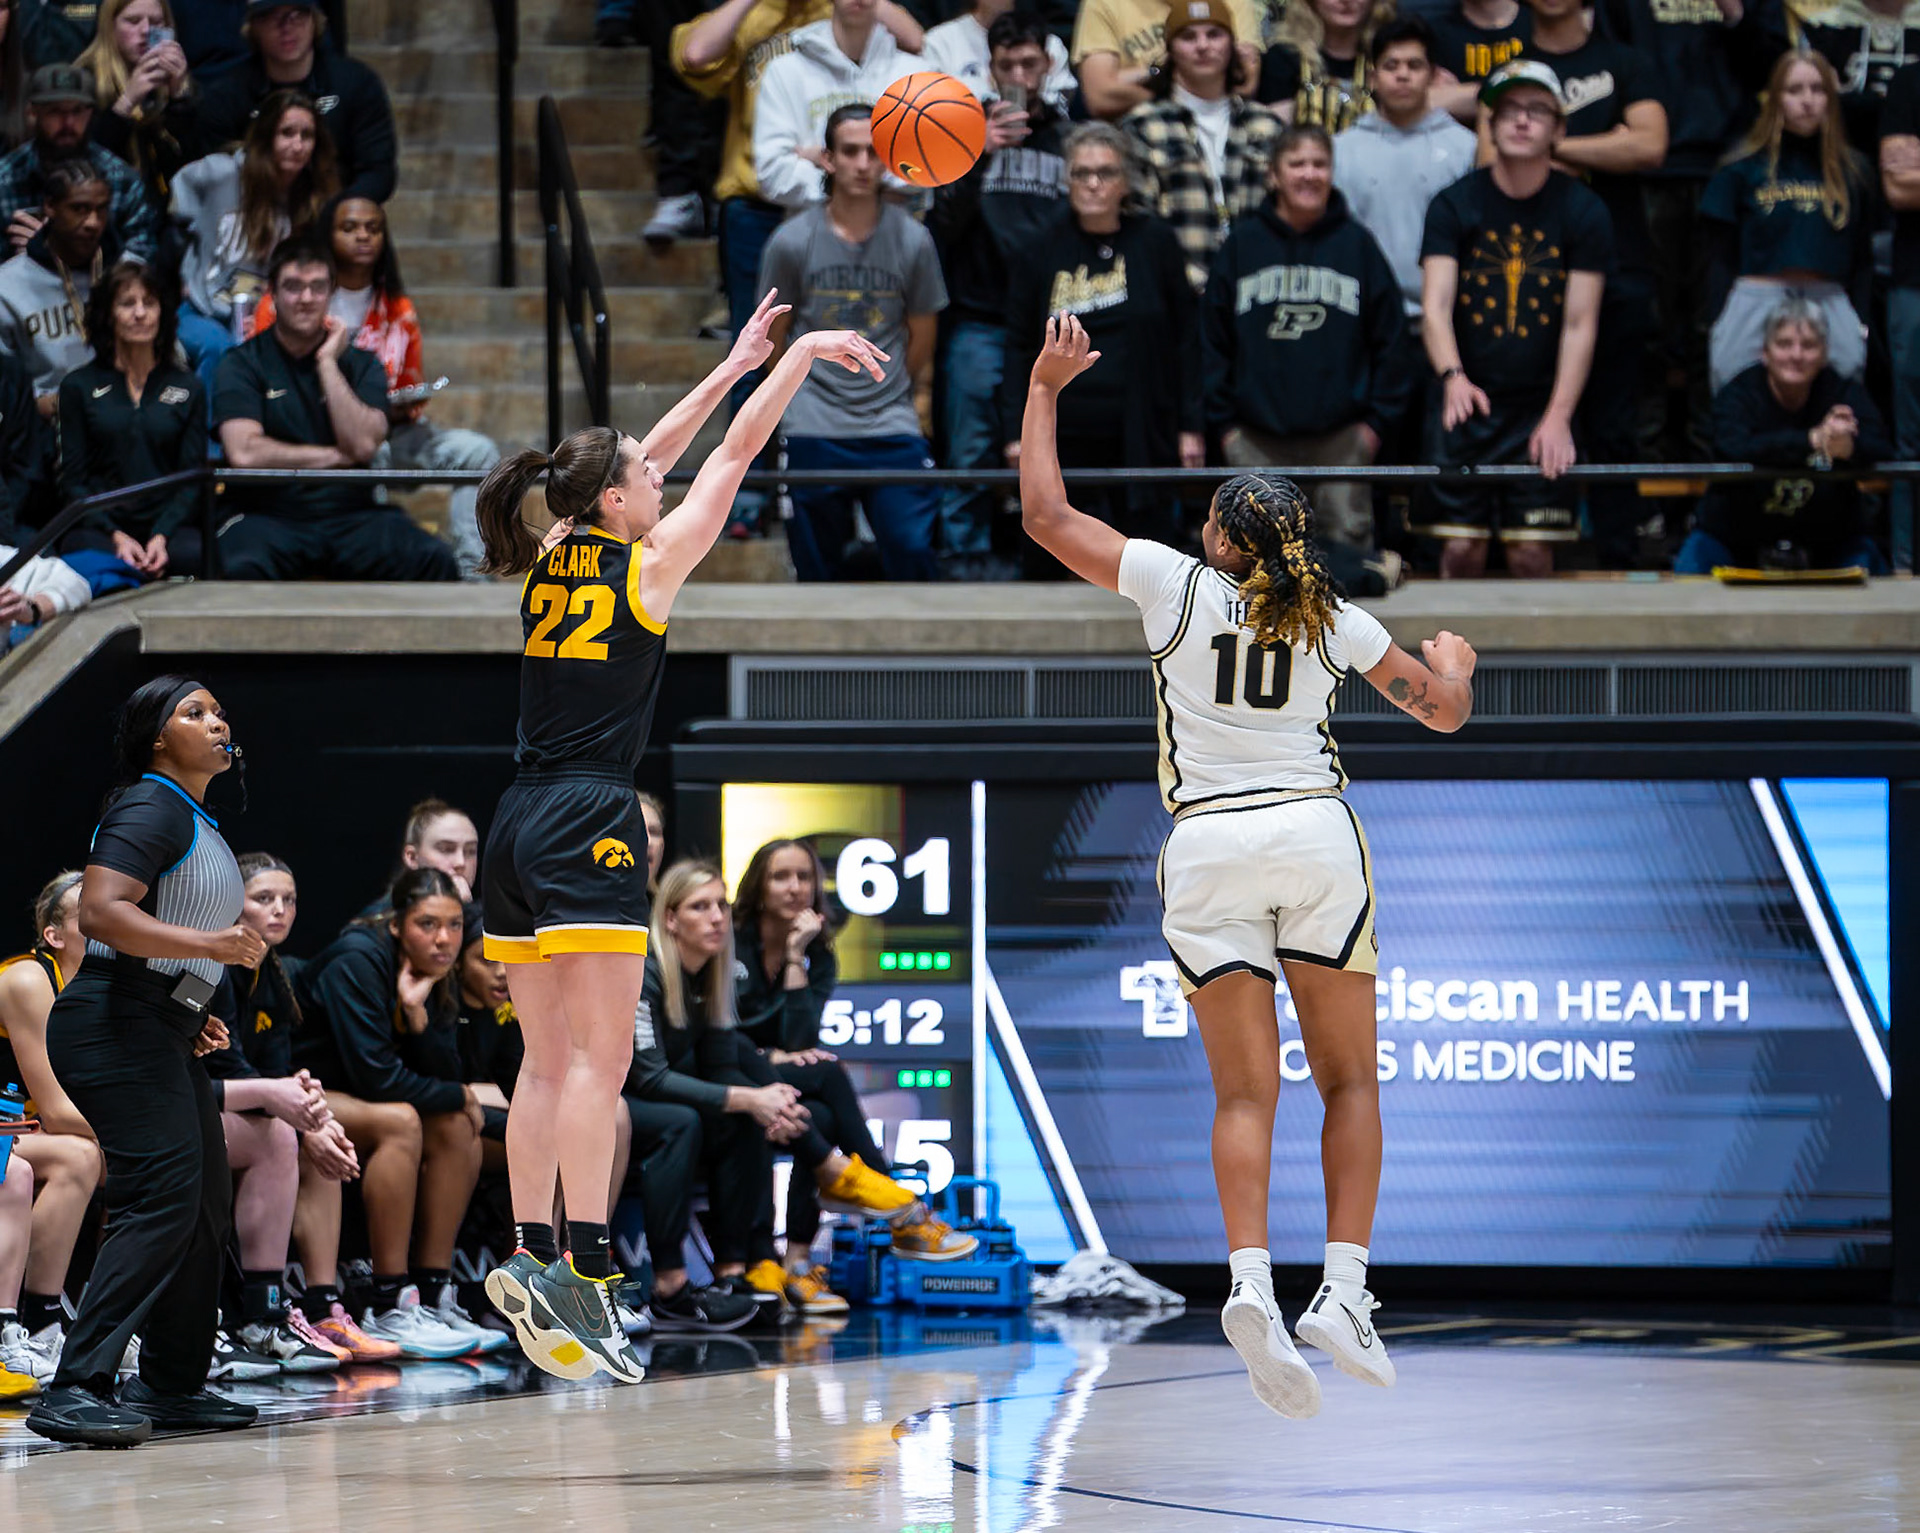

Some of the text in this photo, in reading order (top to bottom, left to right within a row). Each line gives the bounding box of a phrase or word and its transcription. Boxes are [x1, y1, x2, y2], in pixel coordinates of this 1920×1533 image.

[1267, 303, 1327, 340] P
[547, 544, 604, 578] CLARK
[524, 583, 617, 661] 22
[1210, 632, 1293, 711] 10
[836, 836, 950, 916] 61
[818, 998, 945, 1046] 5:12
[1556, 979, 1749, 1023] HEALTH
[1413, 1039, 1636, 1082] MEDICINE
